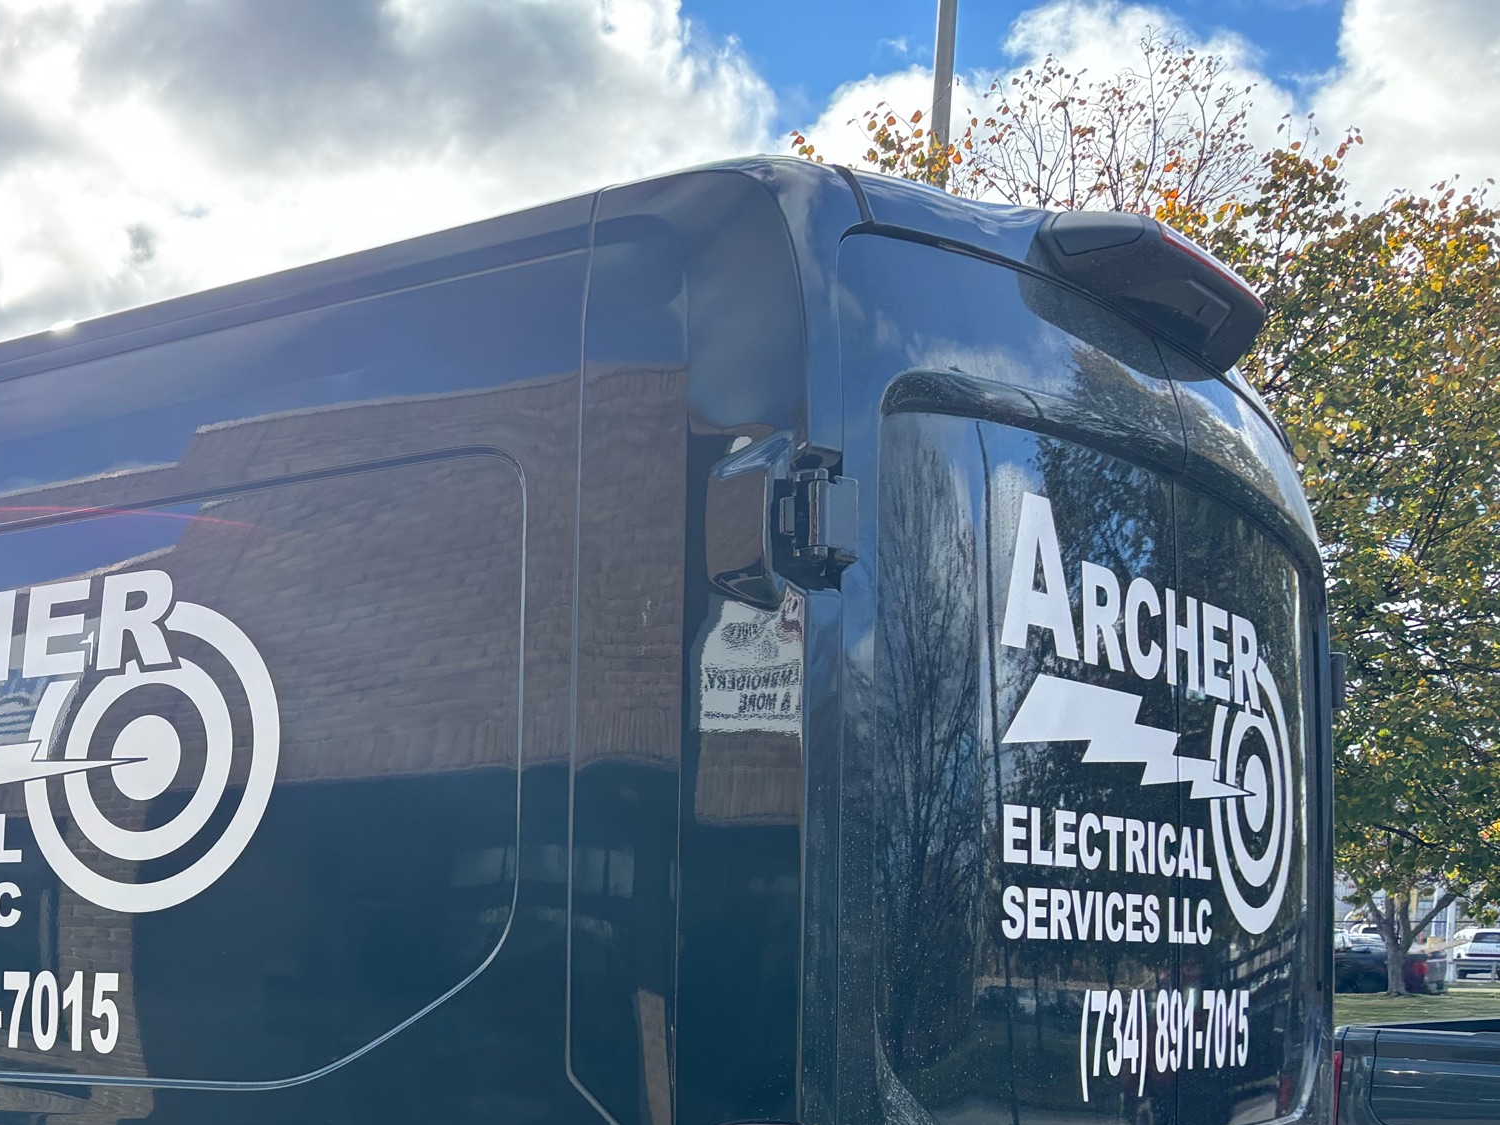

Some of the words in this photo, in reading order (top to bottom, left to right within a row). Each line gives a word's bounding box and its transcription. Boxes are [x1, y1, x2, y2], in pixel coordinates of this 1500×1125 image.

[1001, 491, 1263, 712] ARCHER
[1002, 803, 1212, 881] ELECTRICAL
[1001, 885, 1160, 944] SERVICES
[1168, 896, 1212, 945] LLC
[1080, 988, 1148, 1102] (734)
[1155, 988, 1250, 1073] 891-7015
